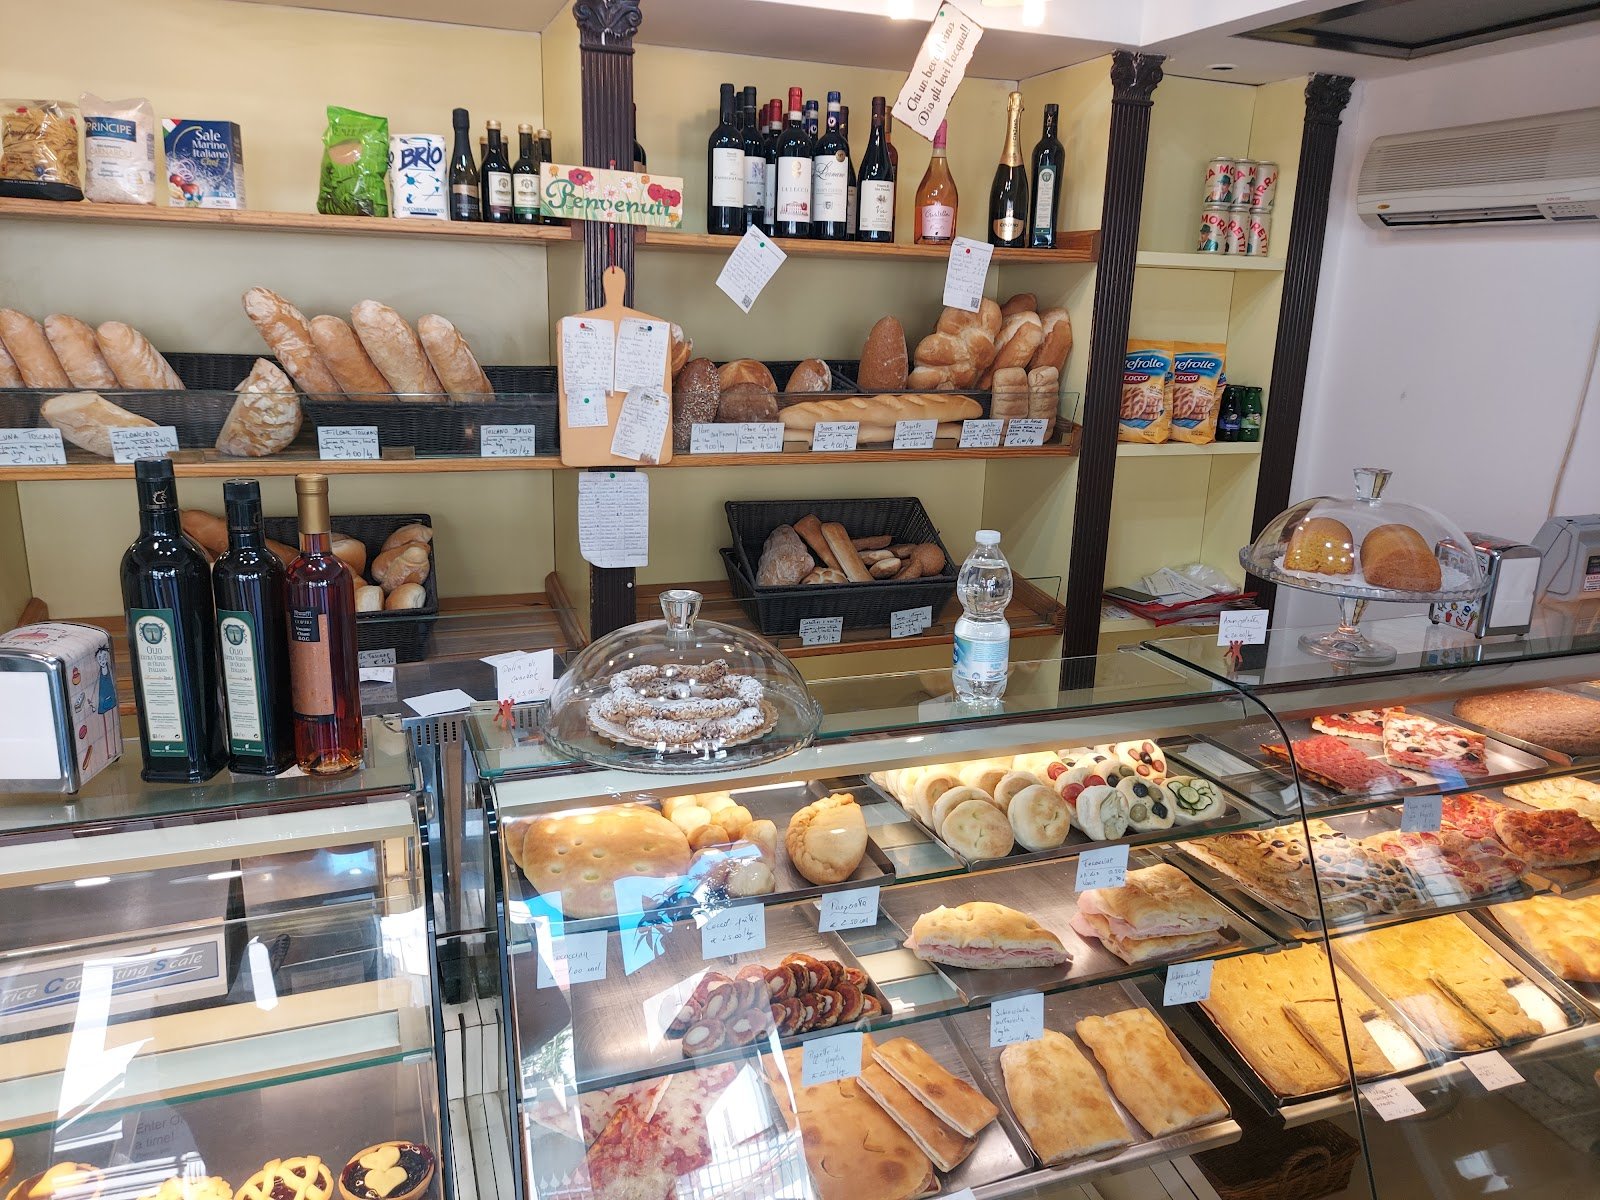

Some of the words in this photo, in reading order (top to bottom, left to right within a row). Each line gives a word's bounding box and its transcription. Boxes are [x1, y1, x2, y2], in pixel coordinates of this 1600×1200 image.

[935, 66, 951, 89] levi
[907, 91, 922, 111] Chi
[918, 81, 929, 95] un
[933, 86, 942, 104] gli
[918, 102, 935, 126] Dio
[86, 121, 132, 135] PRINCIPE
[195, 129, 221, 142] Sale
[192, 140, 226, 151] Marino
[193, 149, 229, 159] Italiano
[398, 146, 443, 171] BRIO
[546, 179, 671, 217] Benvenuti
[147, 646, 163, 655] OLIO
[0, 986, 37, 1004] rice
[154, 953, 203, 973] Scale
[136, 1118, 167, 1136] Enter
[147, 1132, 174, 1148] time!
